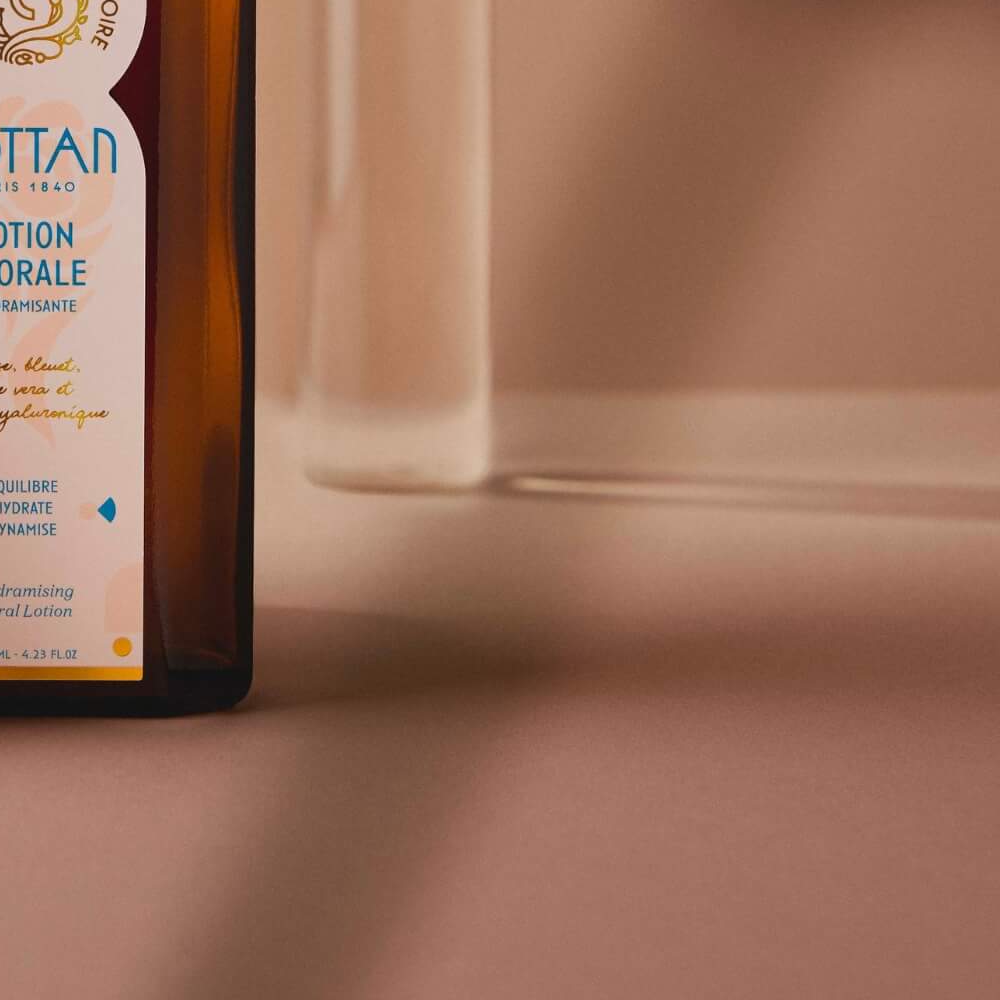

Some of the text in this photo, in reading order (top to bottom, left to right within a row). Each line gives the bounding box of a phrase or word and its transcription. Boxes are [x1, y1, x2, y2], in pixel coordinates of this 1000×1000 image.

[29, 181, 76, 192] 1840
[13, 384, 50, 395] vera
[56, 380, 74, 395] et
[23, 604, 73, 618] Lotion
[21, 650, 47, 660] 4.23
